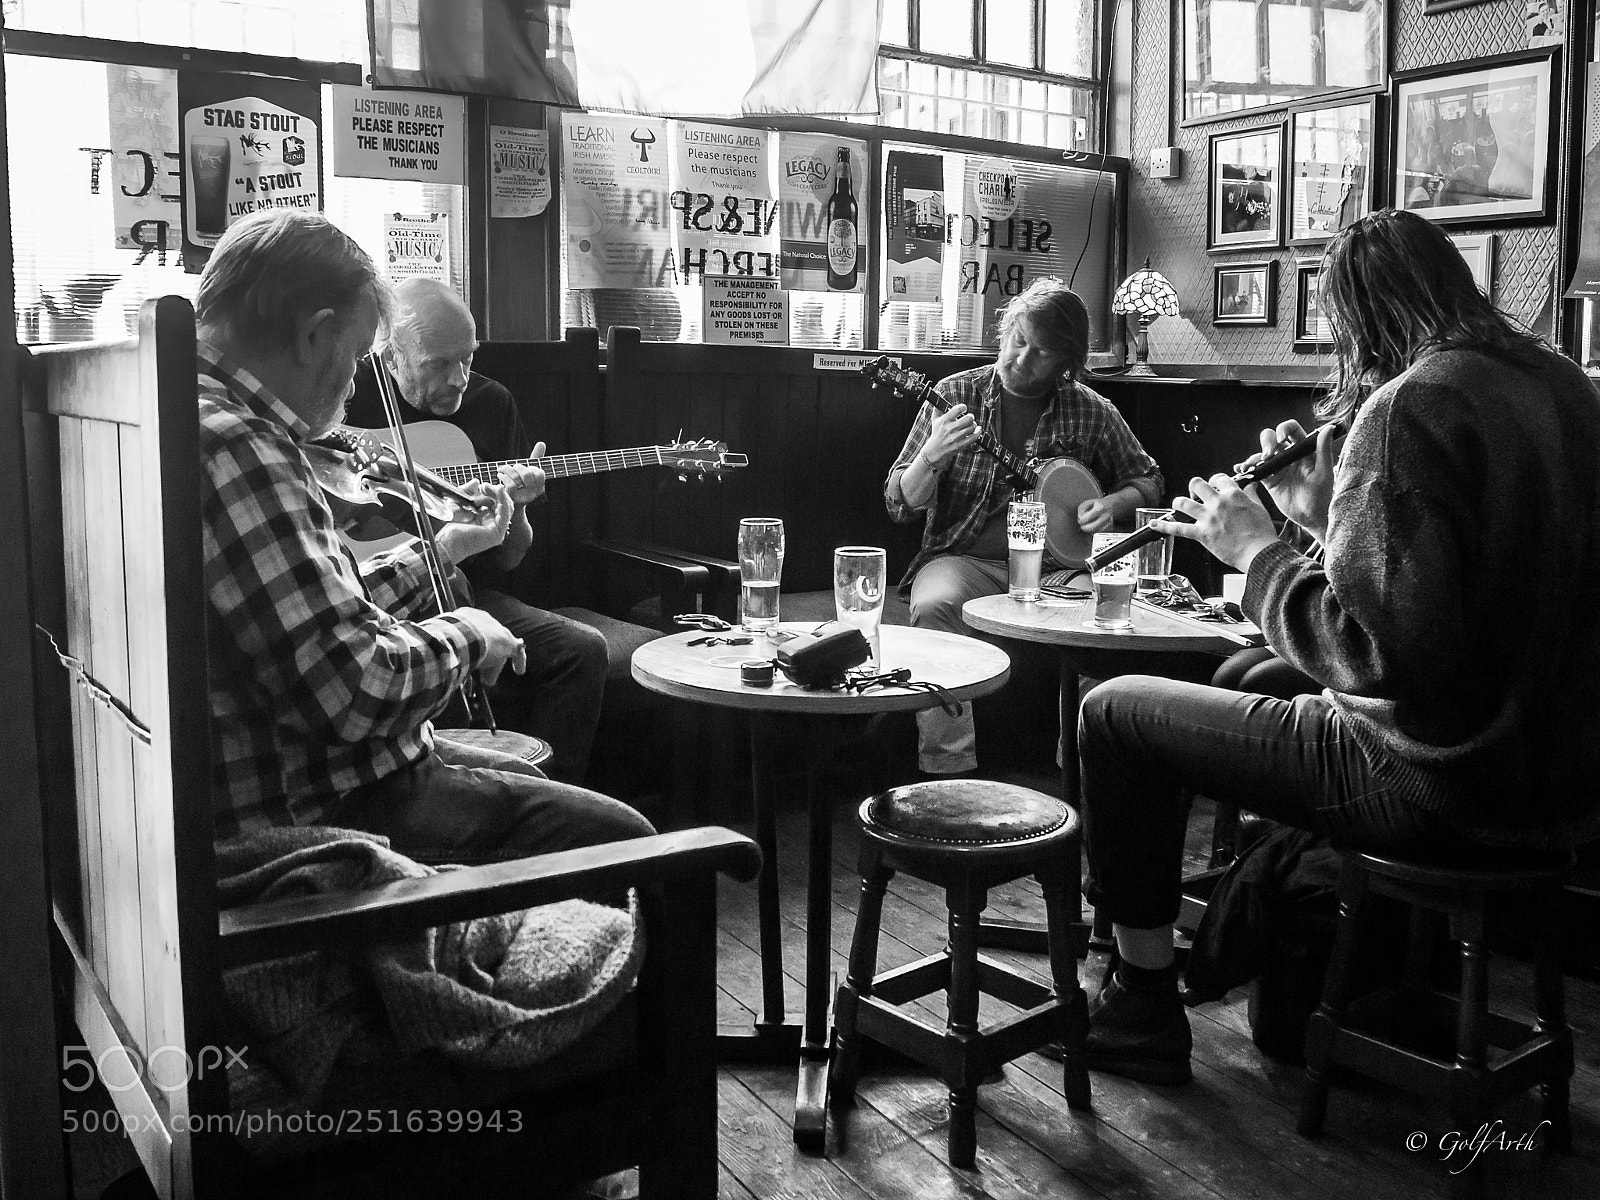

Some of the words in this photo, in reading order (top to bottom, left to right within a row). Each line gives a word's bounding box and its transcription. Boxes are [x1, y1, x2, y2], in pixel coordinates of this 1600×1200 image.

[354, 98, 410, 117] LISTENING
[414, 104, 443, 119] AREA
[203, 107, 245, 129] STAG
[250, 111, 300, 133] STOUT
[352, 116, 393, 134] PLEASE
[397, 120, 445, 137] RESPECT
[570, 126, 615, 143] LEARN
[685, 130, 733, 145] LISTENING
[736, 135, 761, 147] AREA
[357, 135, 378, 150] THE
[382, 137, 440, 155] MUSICIANS
[494, 142, 546, 153] Old-Time
[571, 142, 616, 152] TRADITIONAL
[388, 156, 418, 170] THANK
[420, 158, 438, 171] YOU
[500, 152, 540, 171] MUSIC
[688, 148, 720, 160] Please
[722, 153, 758, 165] respect
[691, 163, 707, 174] the
[710, 166, 757, 178] musicians
[785, 159, 832, 181] LEGACY
[259, 172, 302, 192] STOUT
[711, 180, 731, 188] Thank
[730, 182, 743, 190] you
[228, 201, 255, 217] LIKE
[257, 199, 273, 210] NO
[980, 197, 1015, 206] PILSNER
[389, 230, 442, 238] Old-Time
[395, 241, 436, 257] MUSIC
[783, 250, 791, 258] The
[792, 251, 809, 259] Natural
[809, 252, 827, 260] Choice
[830, 247, 855, 260] LEGACY
[714, 280, 728, 288] THE
[730, 281, 779, 289] MANAGEMENT
[727, 291, 754, 299] ACCEPT
[710, 300, 767, 309] RESPONSIBILITY
[769, 302, 783, 310] FOR
[727, 311, 752, 319] GOODS
[772, 312, 783, 320] OR
[714, 321, 742, 329] STOLEN
[729, 331, 765, 339] PREMISES
[819, 357, 846, 368] Reserved
